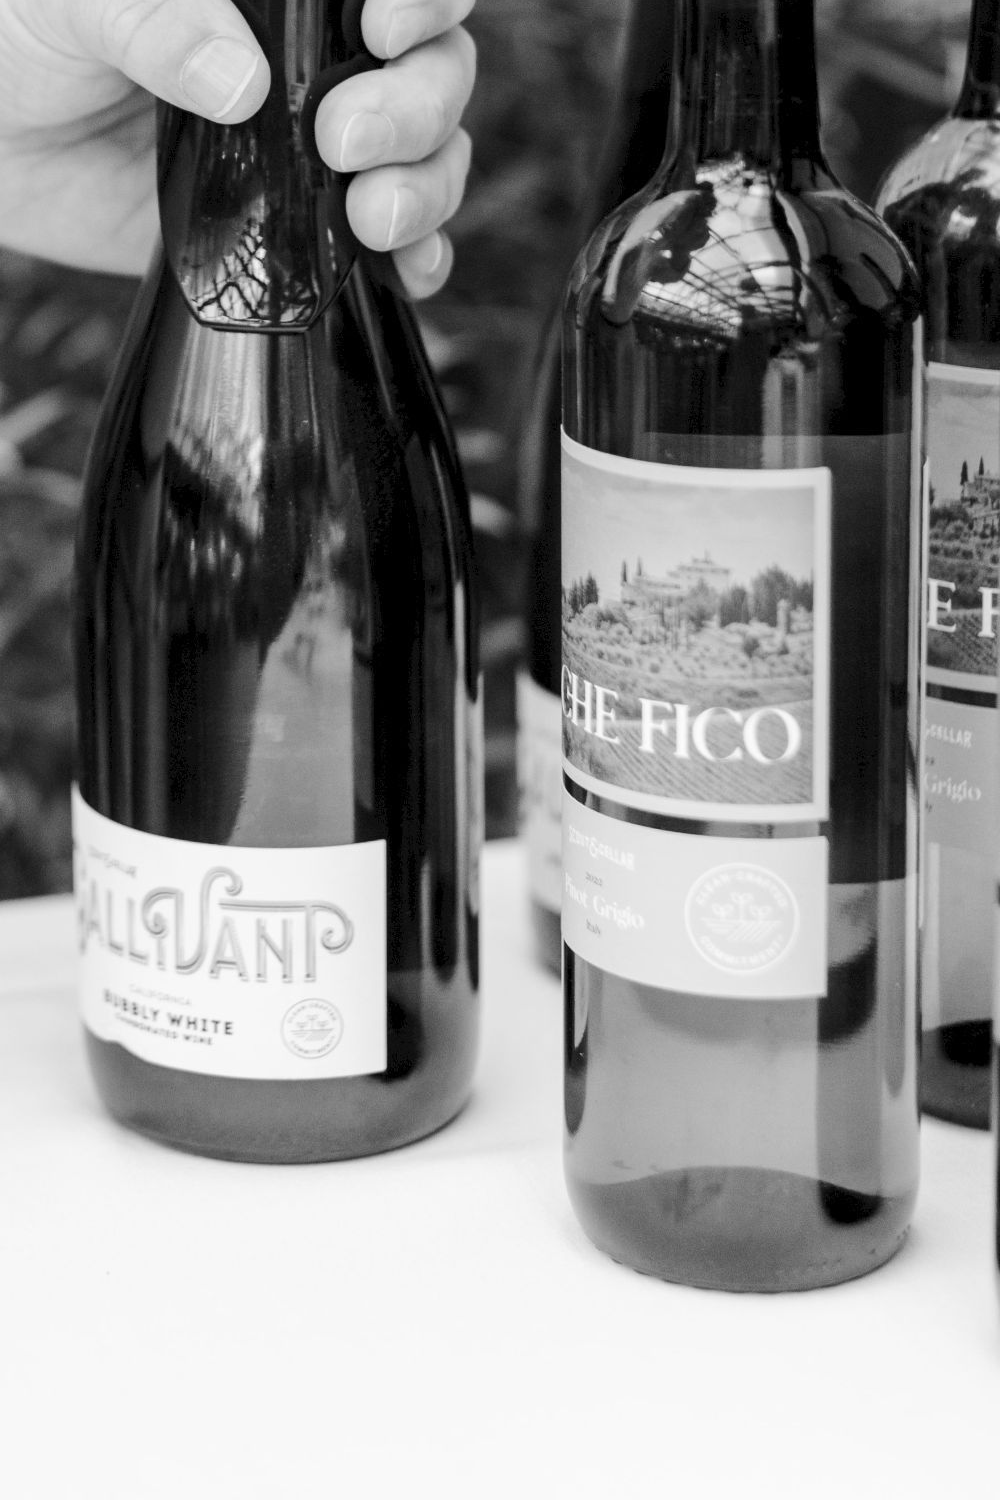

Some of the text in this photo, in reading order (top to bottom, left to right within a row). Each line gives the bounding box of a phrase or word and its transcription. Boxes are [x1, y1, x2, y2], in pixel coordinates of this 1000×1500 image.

[561, 664, 801, 765] CHE FICO
[77, 866, 354, 983] ALLIVANT
[593, 895, 645, 931] Grigio
[104, 989, 234, 1036] BUBBLY WHITE
